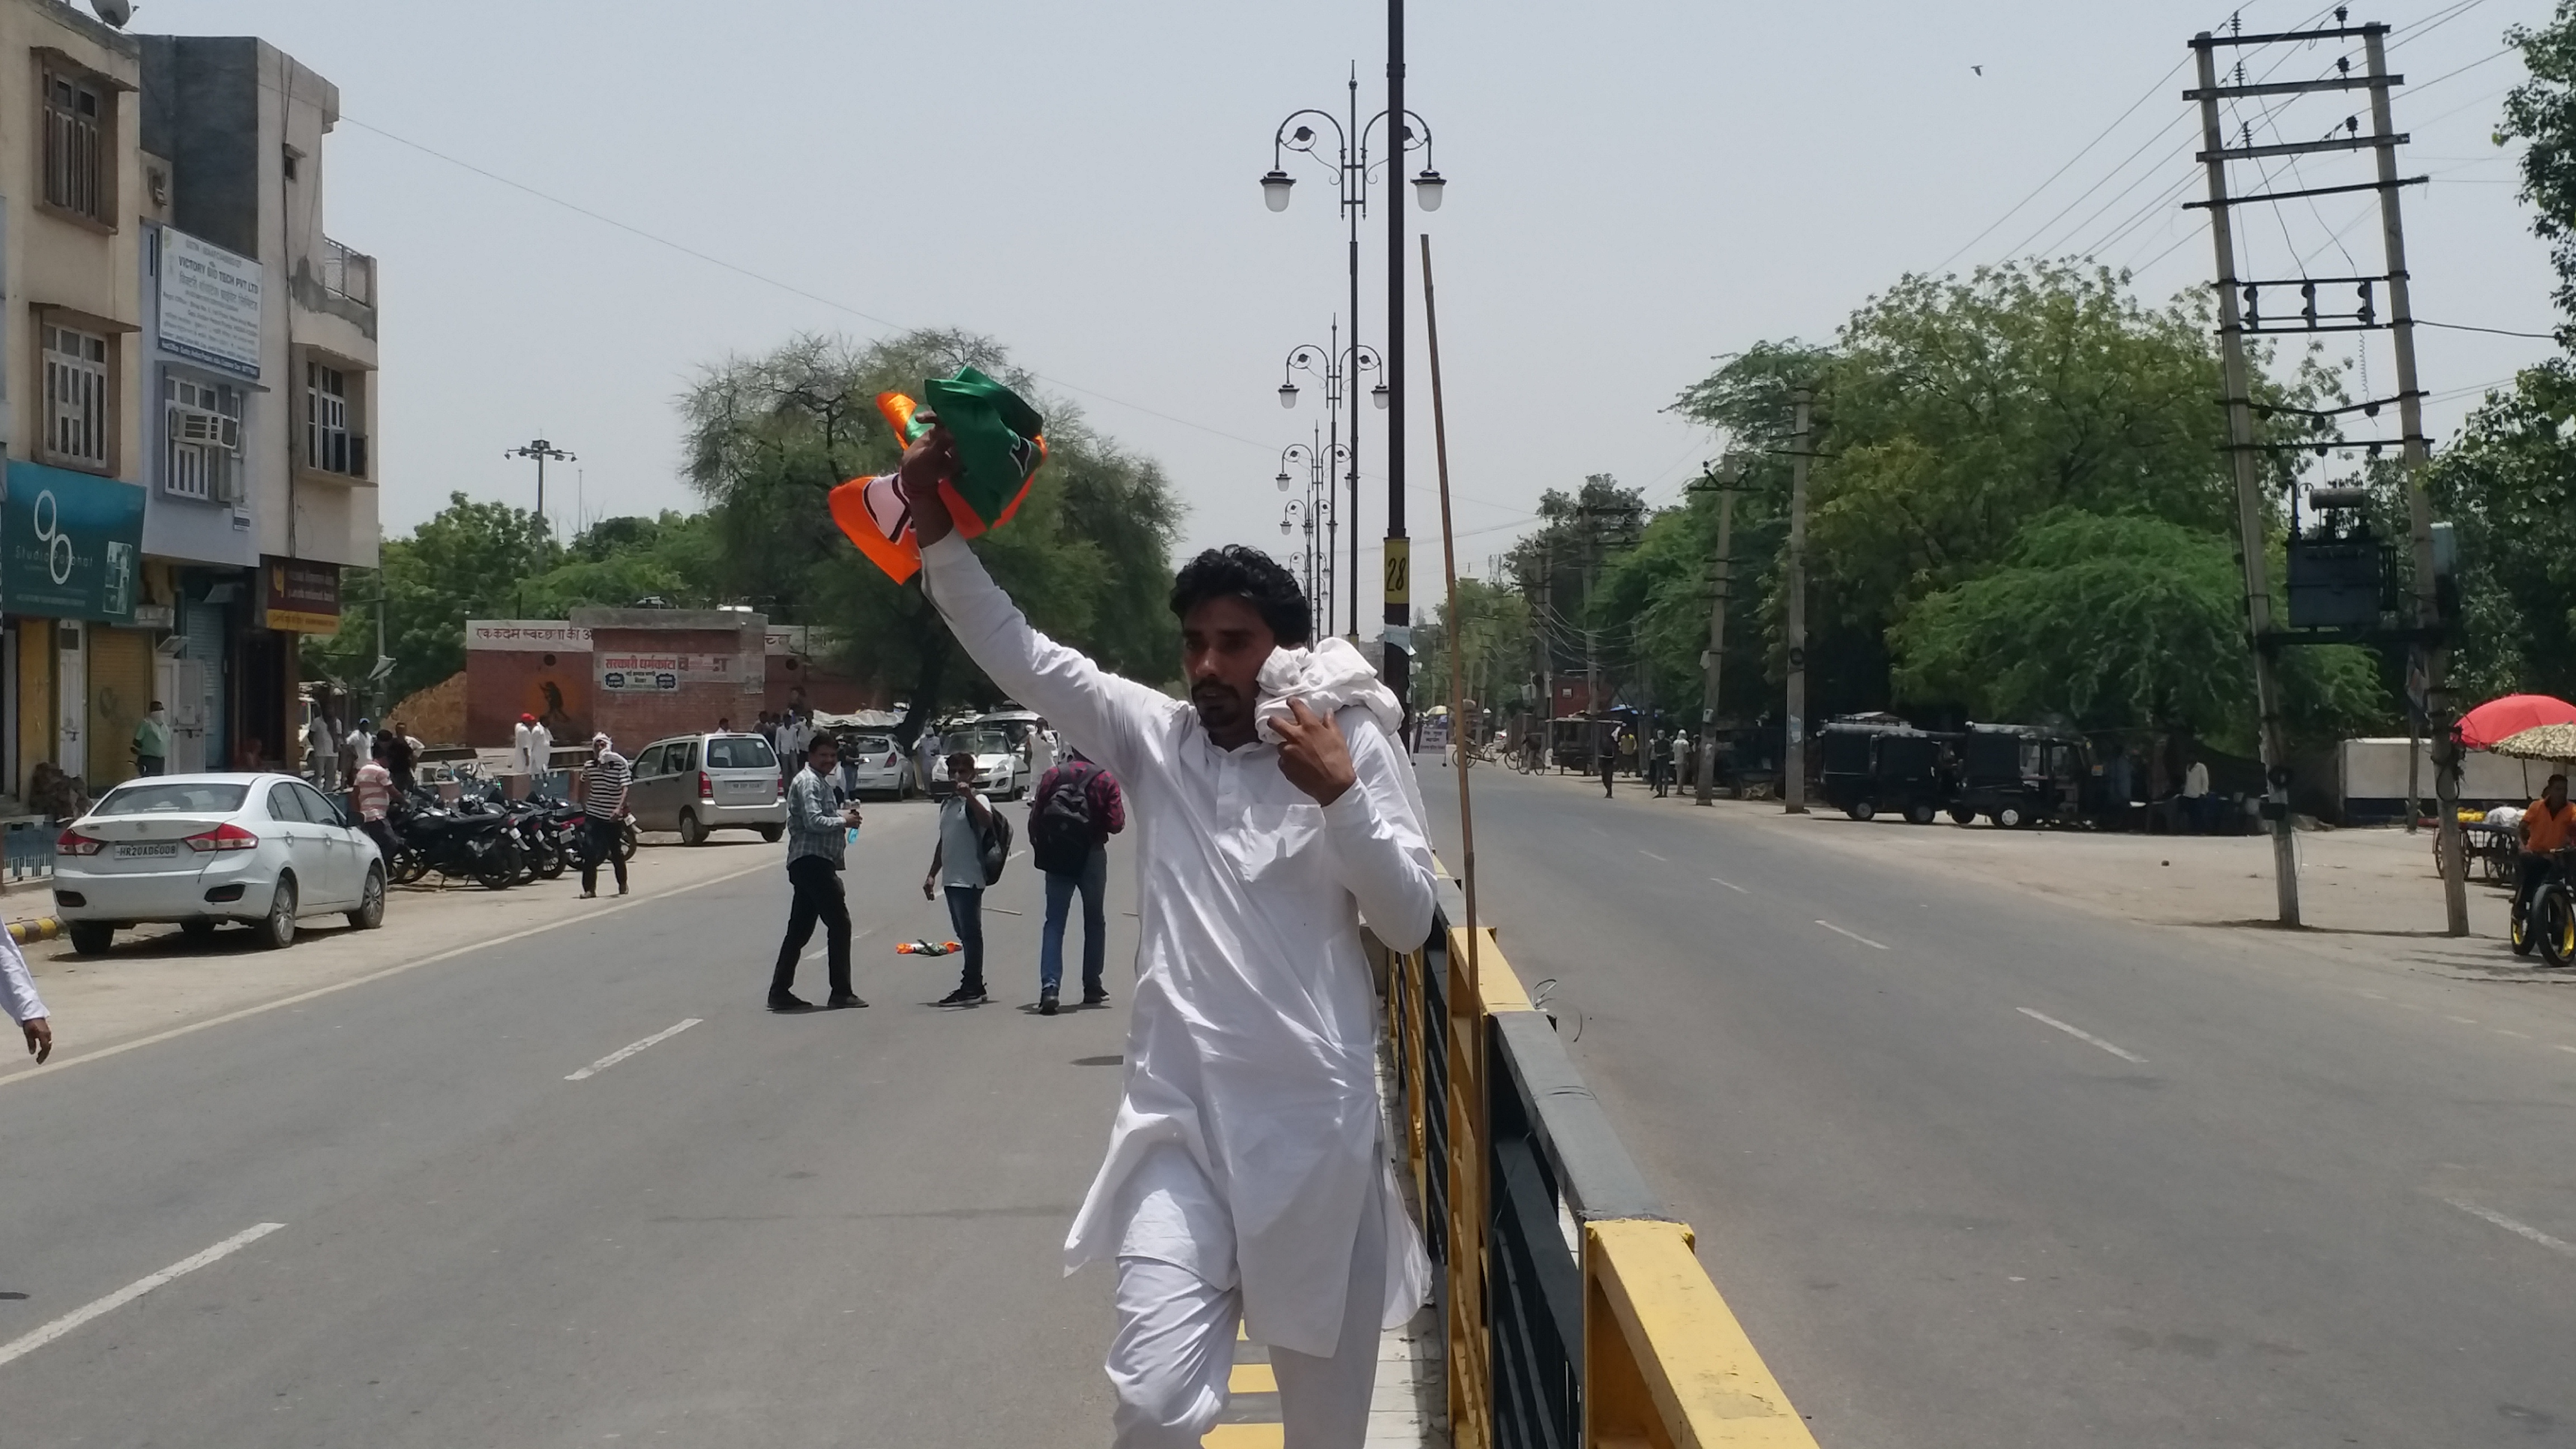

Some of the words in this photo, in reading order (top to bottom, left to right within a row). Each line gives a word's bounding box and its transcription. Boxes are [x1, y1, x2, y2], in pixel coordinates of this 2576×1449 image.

[178, 255, 205, 274] VICTORY
[248, 282, 259, 294] LTD
[1386, 557, 1407, 592] 28
[476, 628, 492, 639] एक
[494, 628, 520, 639] कदम
[605, 655, 637, 669] सरकारी
